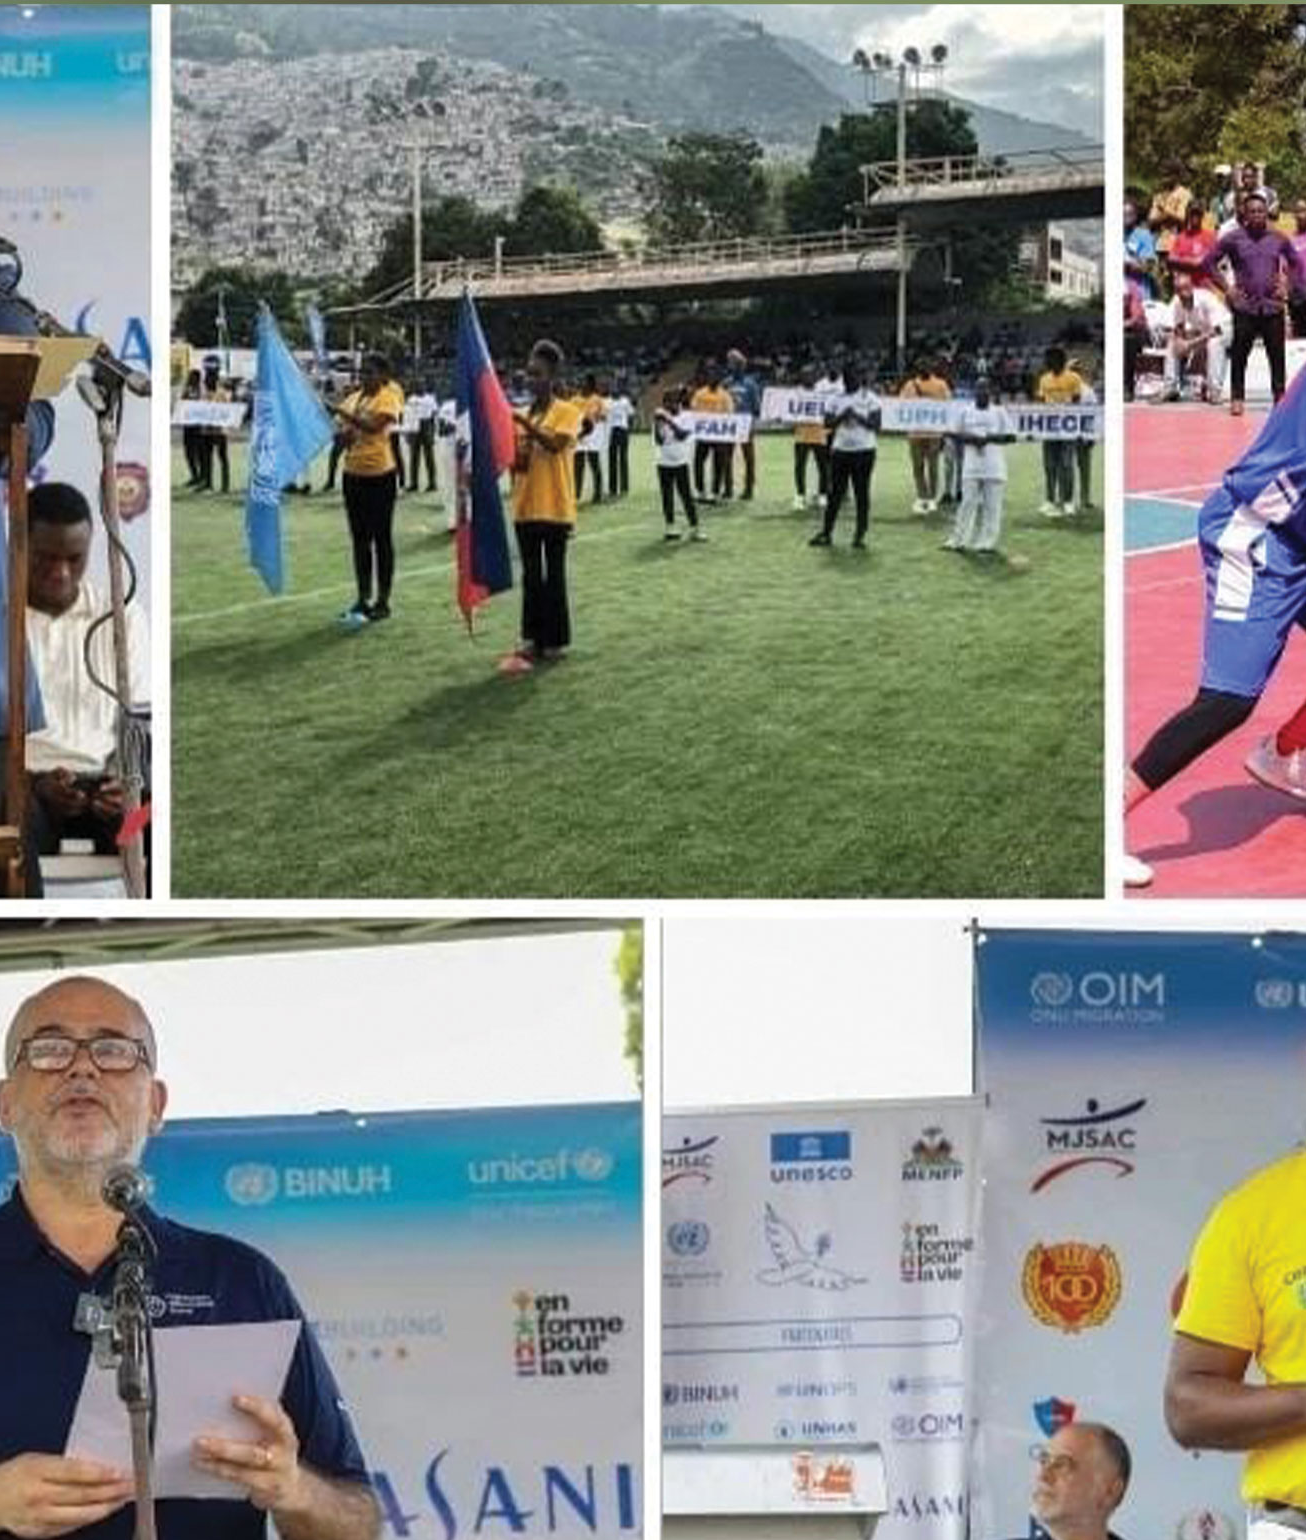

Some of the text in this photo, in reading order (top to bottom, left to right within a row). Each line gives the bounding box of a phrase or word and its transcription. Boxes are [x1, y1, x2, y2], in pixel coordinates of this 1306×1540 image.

[1080, 973, 1166, 1006] OIM
[1048, 1128, 1136, 1149] MJSAC
[468, 1149, 570, 1184] unicef
[771, 1167, 852, 1183] unesco
[285, 1164, 391, 1197] BINUH
[1042, 1274, 1098, 1301] 100
[536, 1295, 569, 1311] en
[539, 1309, 623, 1335] forme
[541, 1334, 607, 1356] pour
[541, 1354, 609, 1375] la vie
